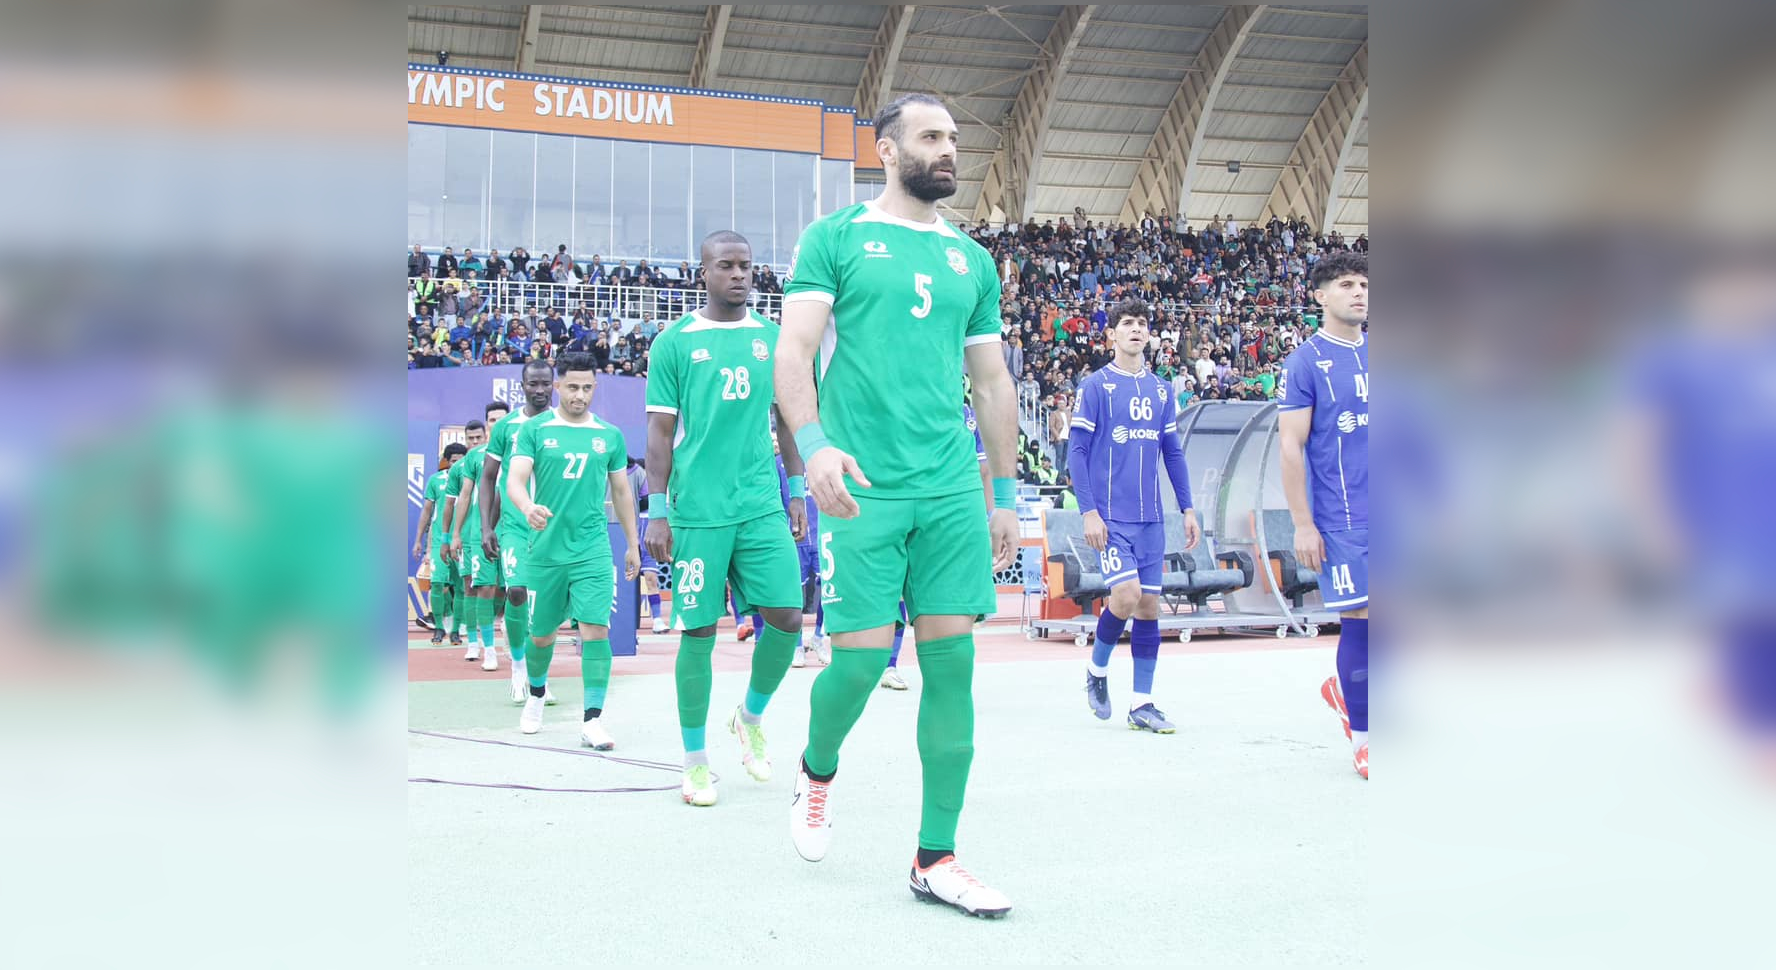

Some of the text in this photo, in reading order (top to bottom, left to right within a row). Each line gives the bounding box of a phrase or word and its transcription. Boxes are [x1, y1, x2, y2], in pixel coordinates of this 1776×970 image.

[408, 73, 674, 126] YMPIC STADIUM
[910, 272, 933, 319] 5
[720, 366, 751, 400] 28
[1129, 396, 1153, 421] 66
[1129, 428, 1160, 441] KOREK
[562, 452, 589, 479] 27
[821, 532, 835, 580] 5
[1100, 546, 1122, 574] 66
[675, 557, 705, 594] 28
[1331, 563, 1356, 596] 44
